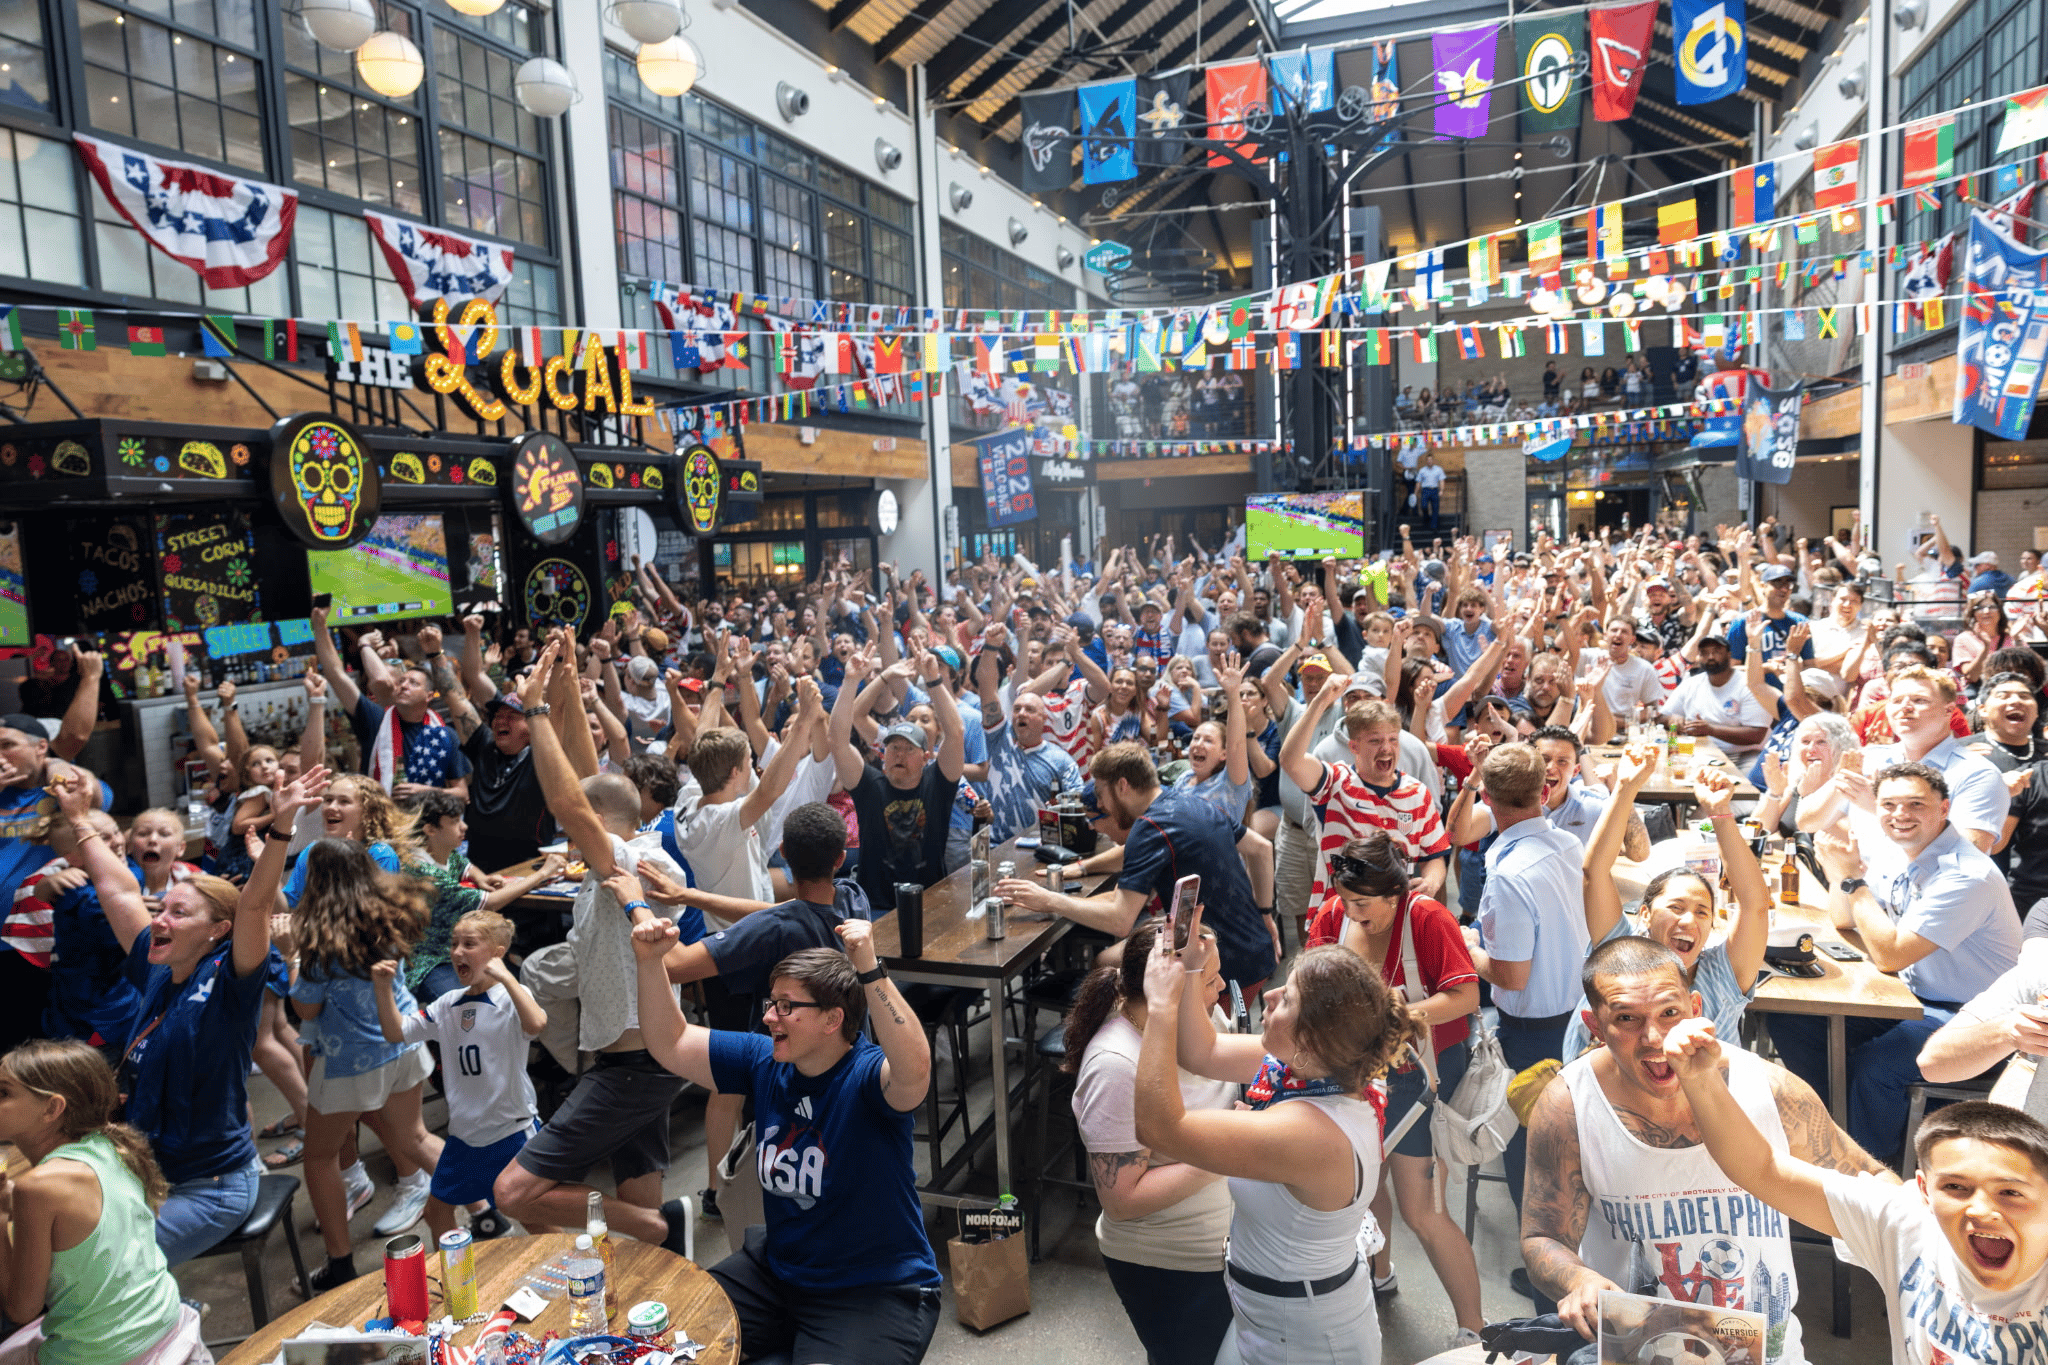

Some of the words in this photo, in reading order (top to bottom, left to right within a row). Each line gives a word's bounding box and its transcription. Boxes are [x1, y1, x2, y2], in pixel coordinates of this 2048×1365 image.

[326, 341, 414, 390] THE
[992, 445, 1012, 516] WELCOME
[1004, 440, 1033, 512] 2026
[167, 524, 228, 552] STREET
[201, 540, 245, 562] CORN
[81, 541, 139, 572] TACOS
[81, 580, 148, 618] NACHOS
[164, 573, 254, 603] QUESADILLAS
[204, 622, 272, 659] STREET
[1064, 711, 1073, 730] 8
[874, 985, 888, 1002] with
[884, 1001, 898, 1017] you
[458, 1044, 482, 1076] 10
[757, 1136, 825, 1197] USA
[1682, 1187, 1726, 1196] BROTHERLY
[1728, 1186, 1744, 1194] LOV
[965, 1214, 1020, 1228] NORFOLK
[1600, 1193, 1784, 1242] PHILADELPHIA
[1713, 1327, 1759, 1337] WATERSIDE
